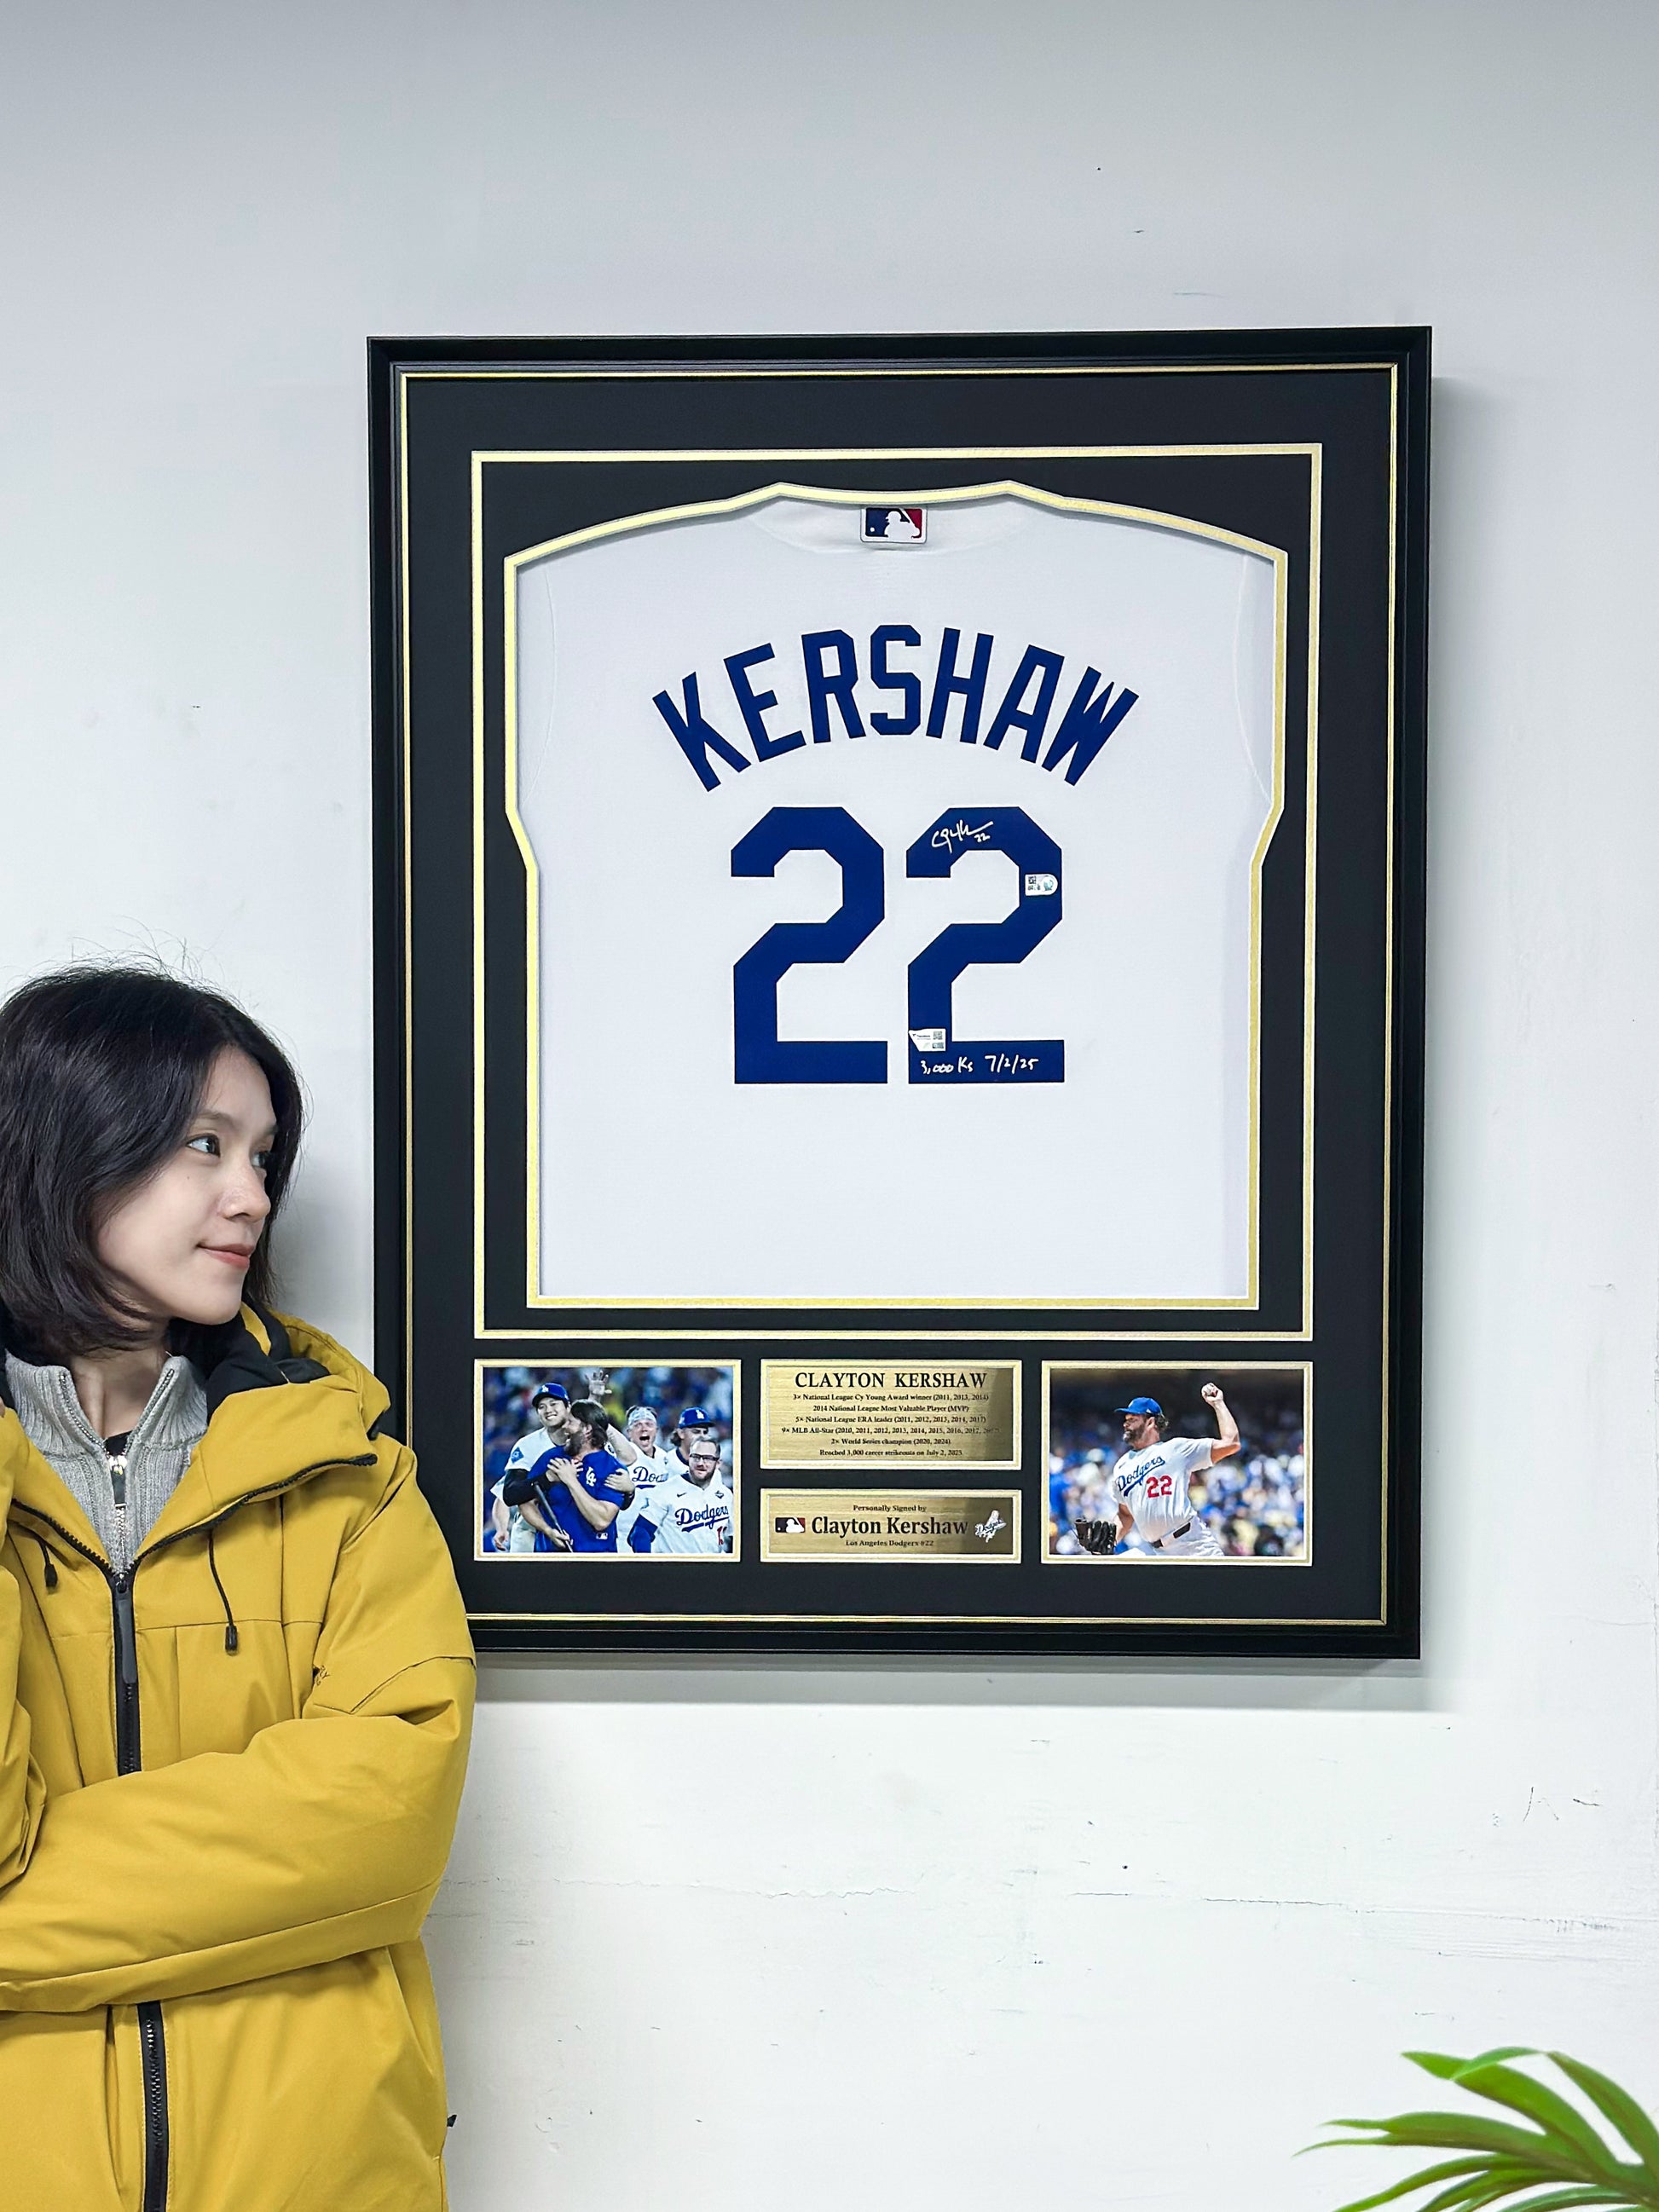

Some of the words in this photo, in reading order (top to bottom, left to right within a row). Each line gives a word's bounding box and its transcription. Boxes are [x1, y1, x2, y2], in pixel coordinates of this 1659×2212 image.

[652, 625, 1139, 792] KERSHAW
[731, 806, 1065, 1084] 22
[921, 1060, 954, 1075] 3,000
[957, 1056, 974, 1073] Ks
[984, 1053, 1039, 1074] 7/2/25
[795, 1372, 886, 1388] CLAYTON
[894, 1372, 988, 1389] KERSHAW
[1117, 1456, 1165, 1492] Dodgers
[1146, 1475, 1172, 1498] 22
[674, 1504, 730, 1529] Dodgers
[812, 1516, 882, 1538] Clayton
[887, 1516, 968, 1534] Kershaw
[888, 1539, 919, 1548] Dodgers
